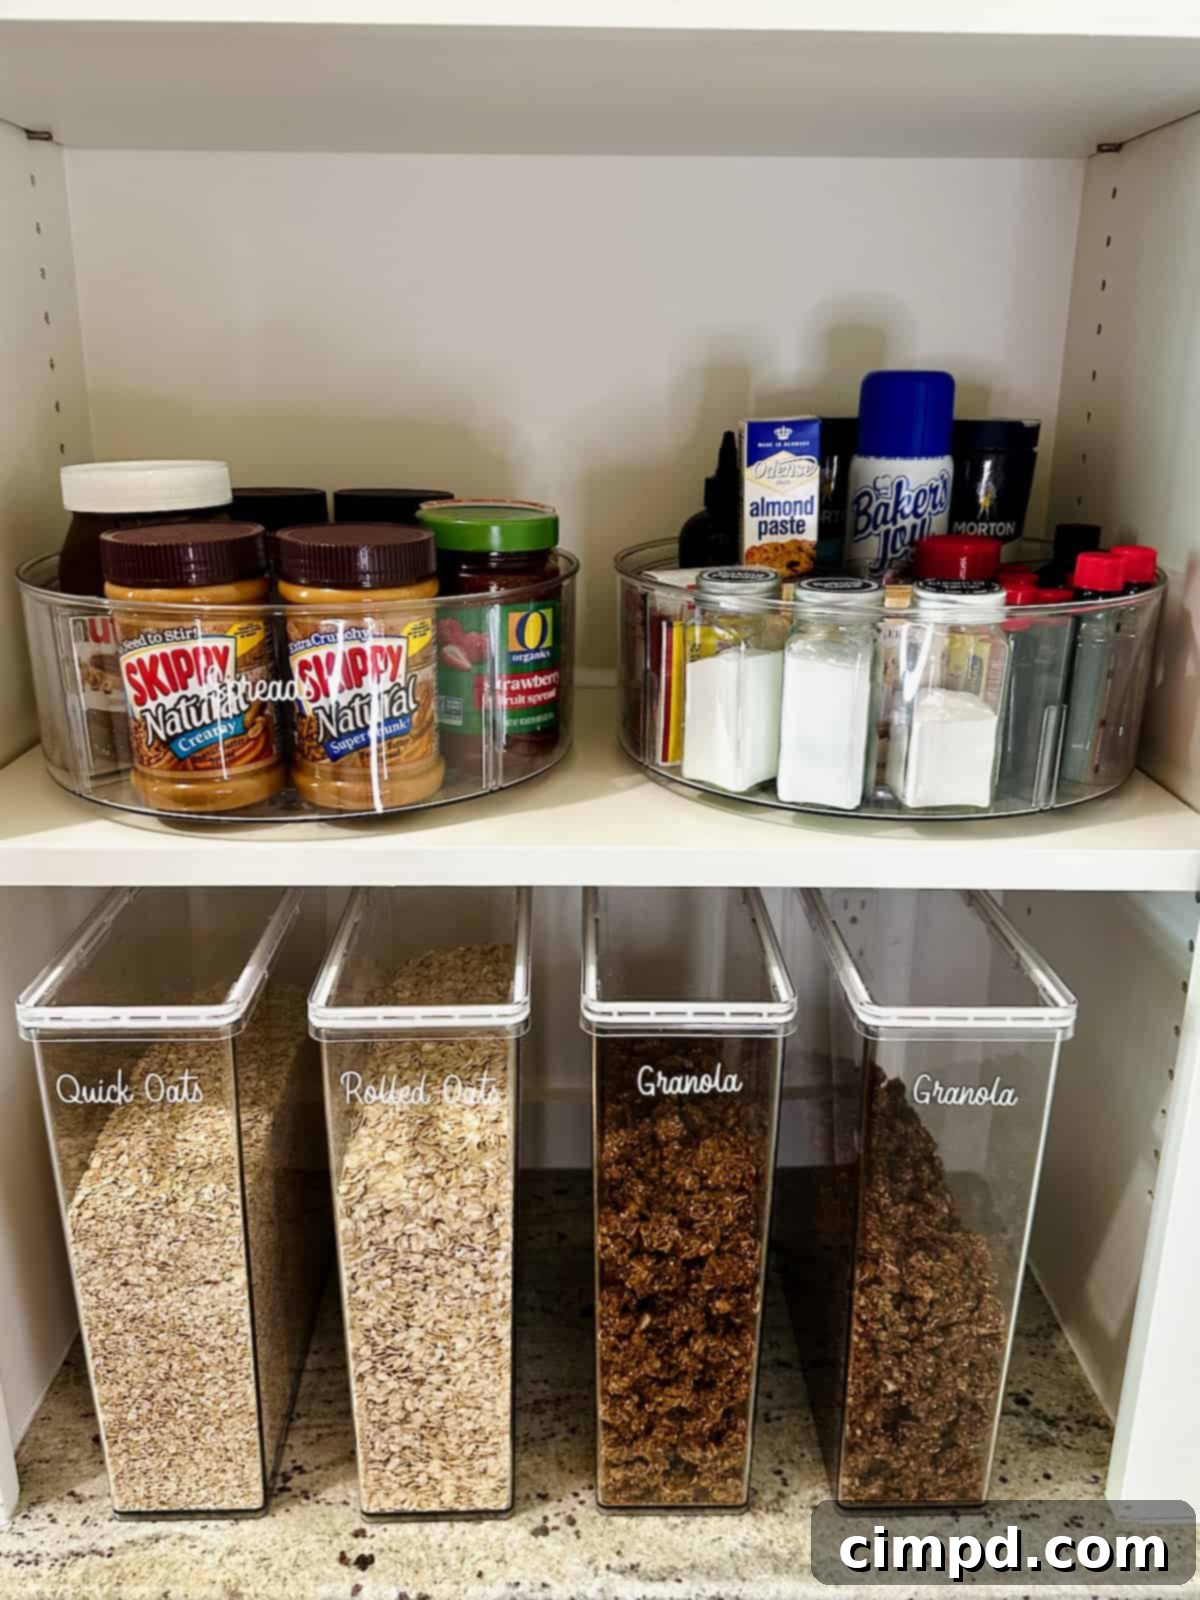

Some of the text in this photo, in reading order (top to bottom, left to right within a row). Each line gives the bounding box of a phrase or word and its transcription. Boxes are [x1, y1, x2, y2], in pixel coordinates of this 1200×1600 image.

[749, 495, 814, 517] almond
[853, 472, 948, 537] Baker's
[757, 516, 806, 541] paste
[953, 521, 1017, 536] MORTON
[147, 633, 163, 645] to
[163, 627, 198, 642] Stir!
[511, 650, 551, 663] organics
[124, 645, 230, 706] SKIPPY
[177, 718, 237, 753] Creamy
[330, 732, 367, 754] Super
[56, 1067, 204, 1104] Quick Oats
[340, 1065, 500, 1105] Rolled Oats
[637, 1063, 743, 1096] Granola
[913, 1074, 1019, 1107] Granola
